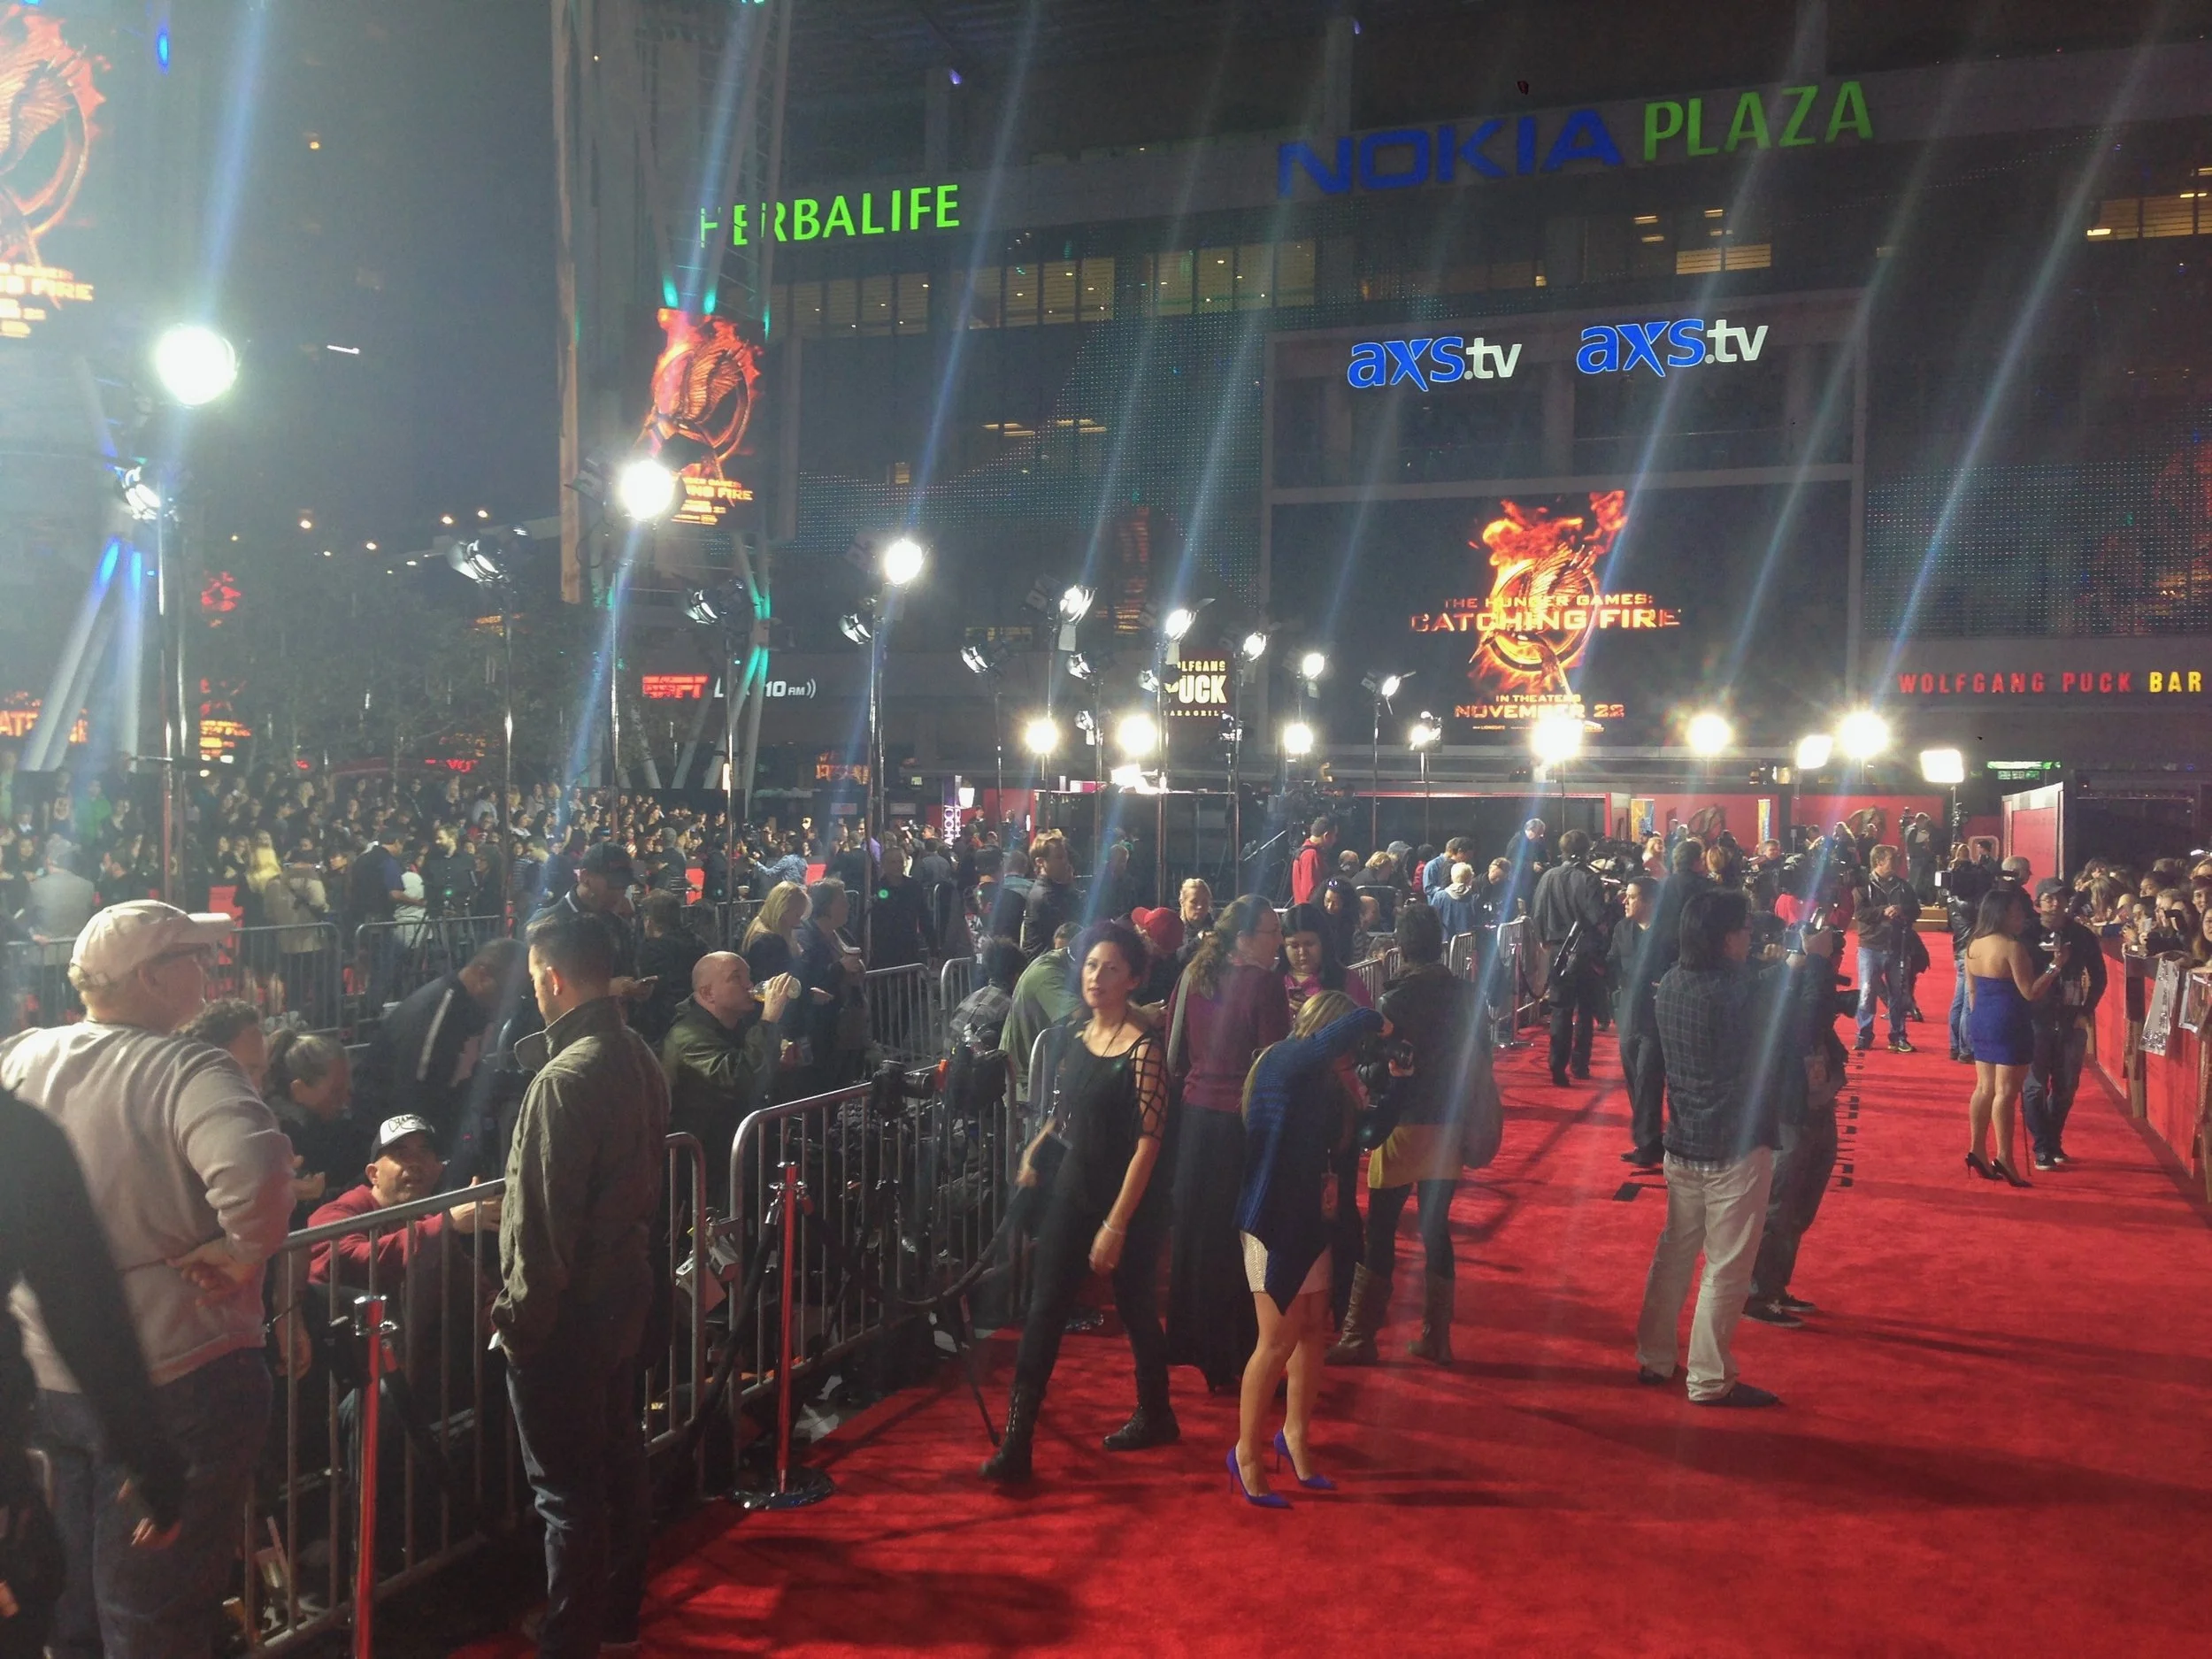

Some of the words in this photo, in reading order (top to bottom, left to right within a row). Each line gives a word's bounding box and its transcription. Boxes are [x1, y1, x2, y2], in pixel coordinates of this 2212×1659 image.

[1278, 110, 1624, 198] NOKIA
[1644, 81, 1874, 161] PLAZA
[700, 184, 960, 249] HERBALIFE
[1347, 336, 1523, 392] axs.tv
[1577, 319, 1769, 377] axs.tv
[1410, 609, 1588, 632] CATCHING
[1599, 608, 1680, 629] FIRE
[1485, 595, 1570, 608] HUNGER
[1576, 594, 1654, 606] GAMES:
[1897, 672, 2046, 694] WOLFGANG
[2062, 672, 2132, 693] PUCK
[2148, 672, 2202, 693] BAR
[1594, 703, 1625, 718] 22
